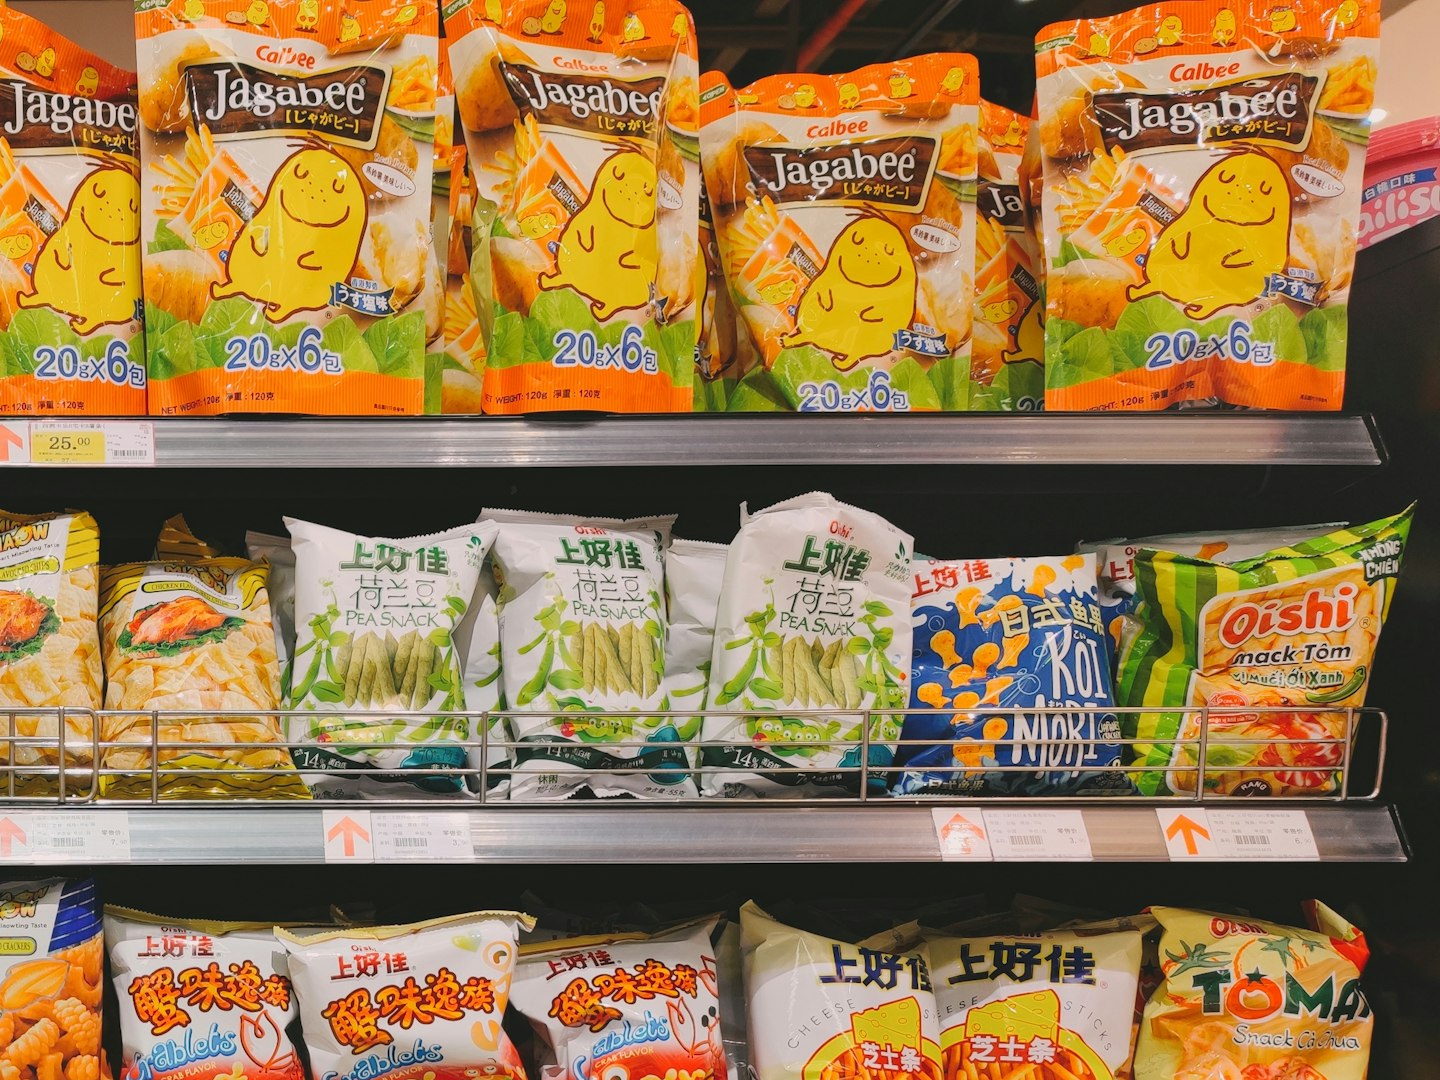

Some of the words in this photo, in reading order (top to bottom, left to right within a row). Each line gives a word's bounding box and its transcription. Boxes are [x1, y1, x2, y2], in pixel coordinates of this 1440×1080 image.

[256, 44, 315, 69] Calbee
[554, 56, 609, 75] Calbee
[1170, 61, 1241, 83] Calbee
[205, 66, 365, 121] Jagabee
[1118, 82, 1298, 141] Jagabee
[806, 118, 869, 139] Calbee
[766, 149, 915, 193] Jagabee
[1364, 174, 1417, 201] 白桃口味
[337, 283, 388, 311] うす塩味
[900, 328, 948, 352] うす塩味
[48, 436, 91, 451] 25.00
[339, 542, 451, 575] 上好佳
[556, 539, 644, 570] 上好佳
[350, 577, 436, 610] 荷兰豆
[573, 571, 641, 602] 荷兰豆
[346, 611, 376, 626] PEA
[378, 612, 440, 629] SNACK
[573, 601, 600, 616] PEA
[602, 603, 650, 621] SNACK
[1221, 583, 1357, 648] Oishi
[780, 612, 810, 631] PEA
[812, 618, 856, 638] SNACK
[1045, 623, 1107, 700] KOI
[1304, 644, 1351, 663] Tôm
[1306, 670, 1344, 688] Xanh
[1241, 780, 1268, 792] RANG
[3, 942, 31, 950] CRACKERS
[330, 952, 409, 980] 上好佳
[948, 943, 1097, 985] 上好佳
[787, 998, 856, 1050] CHEESE
[1064, 1001, 1112, 1051] STICKS
[1233, 1024, 1293, 1047] Snack
[1297, 1031, 1315, 1049] Cà
[1317, 1030, 1360, 1049] Chua
[861, 1042, 921, 1073] 芝士条
[969, 1036, 1055, 1063] 芝士条
[186, 1061, 217, 1078] FLAVOR
